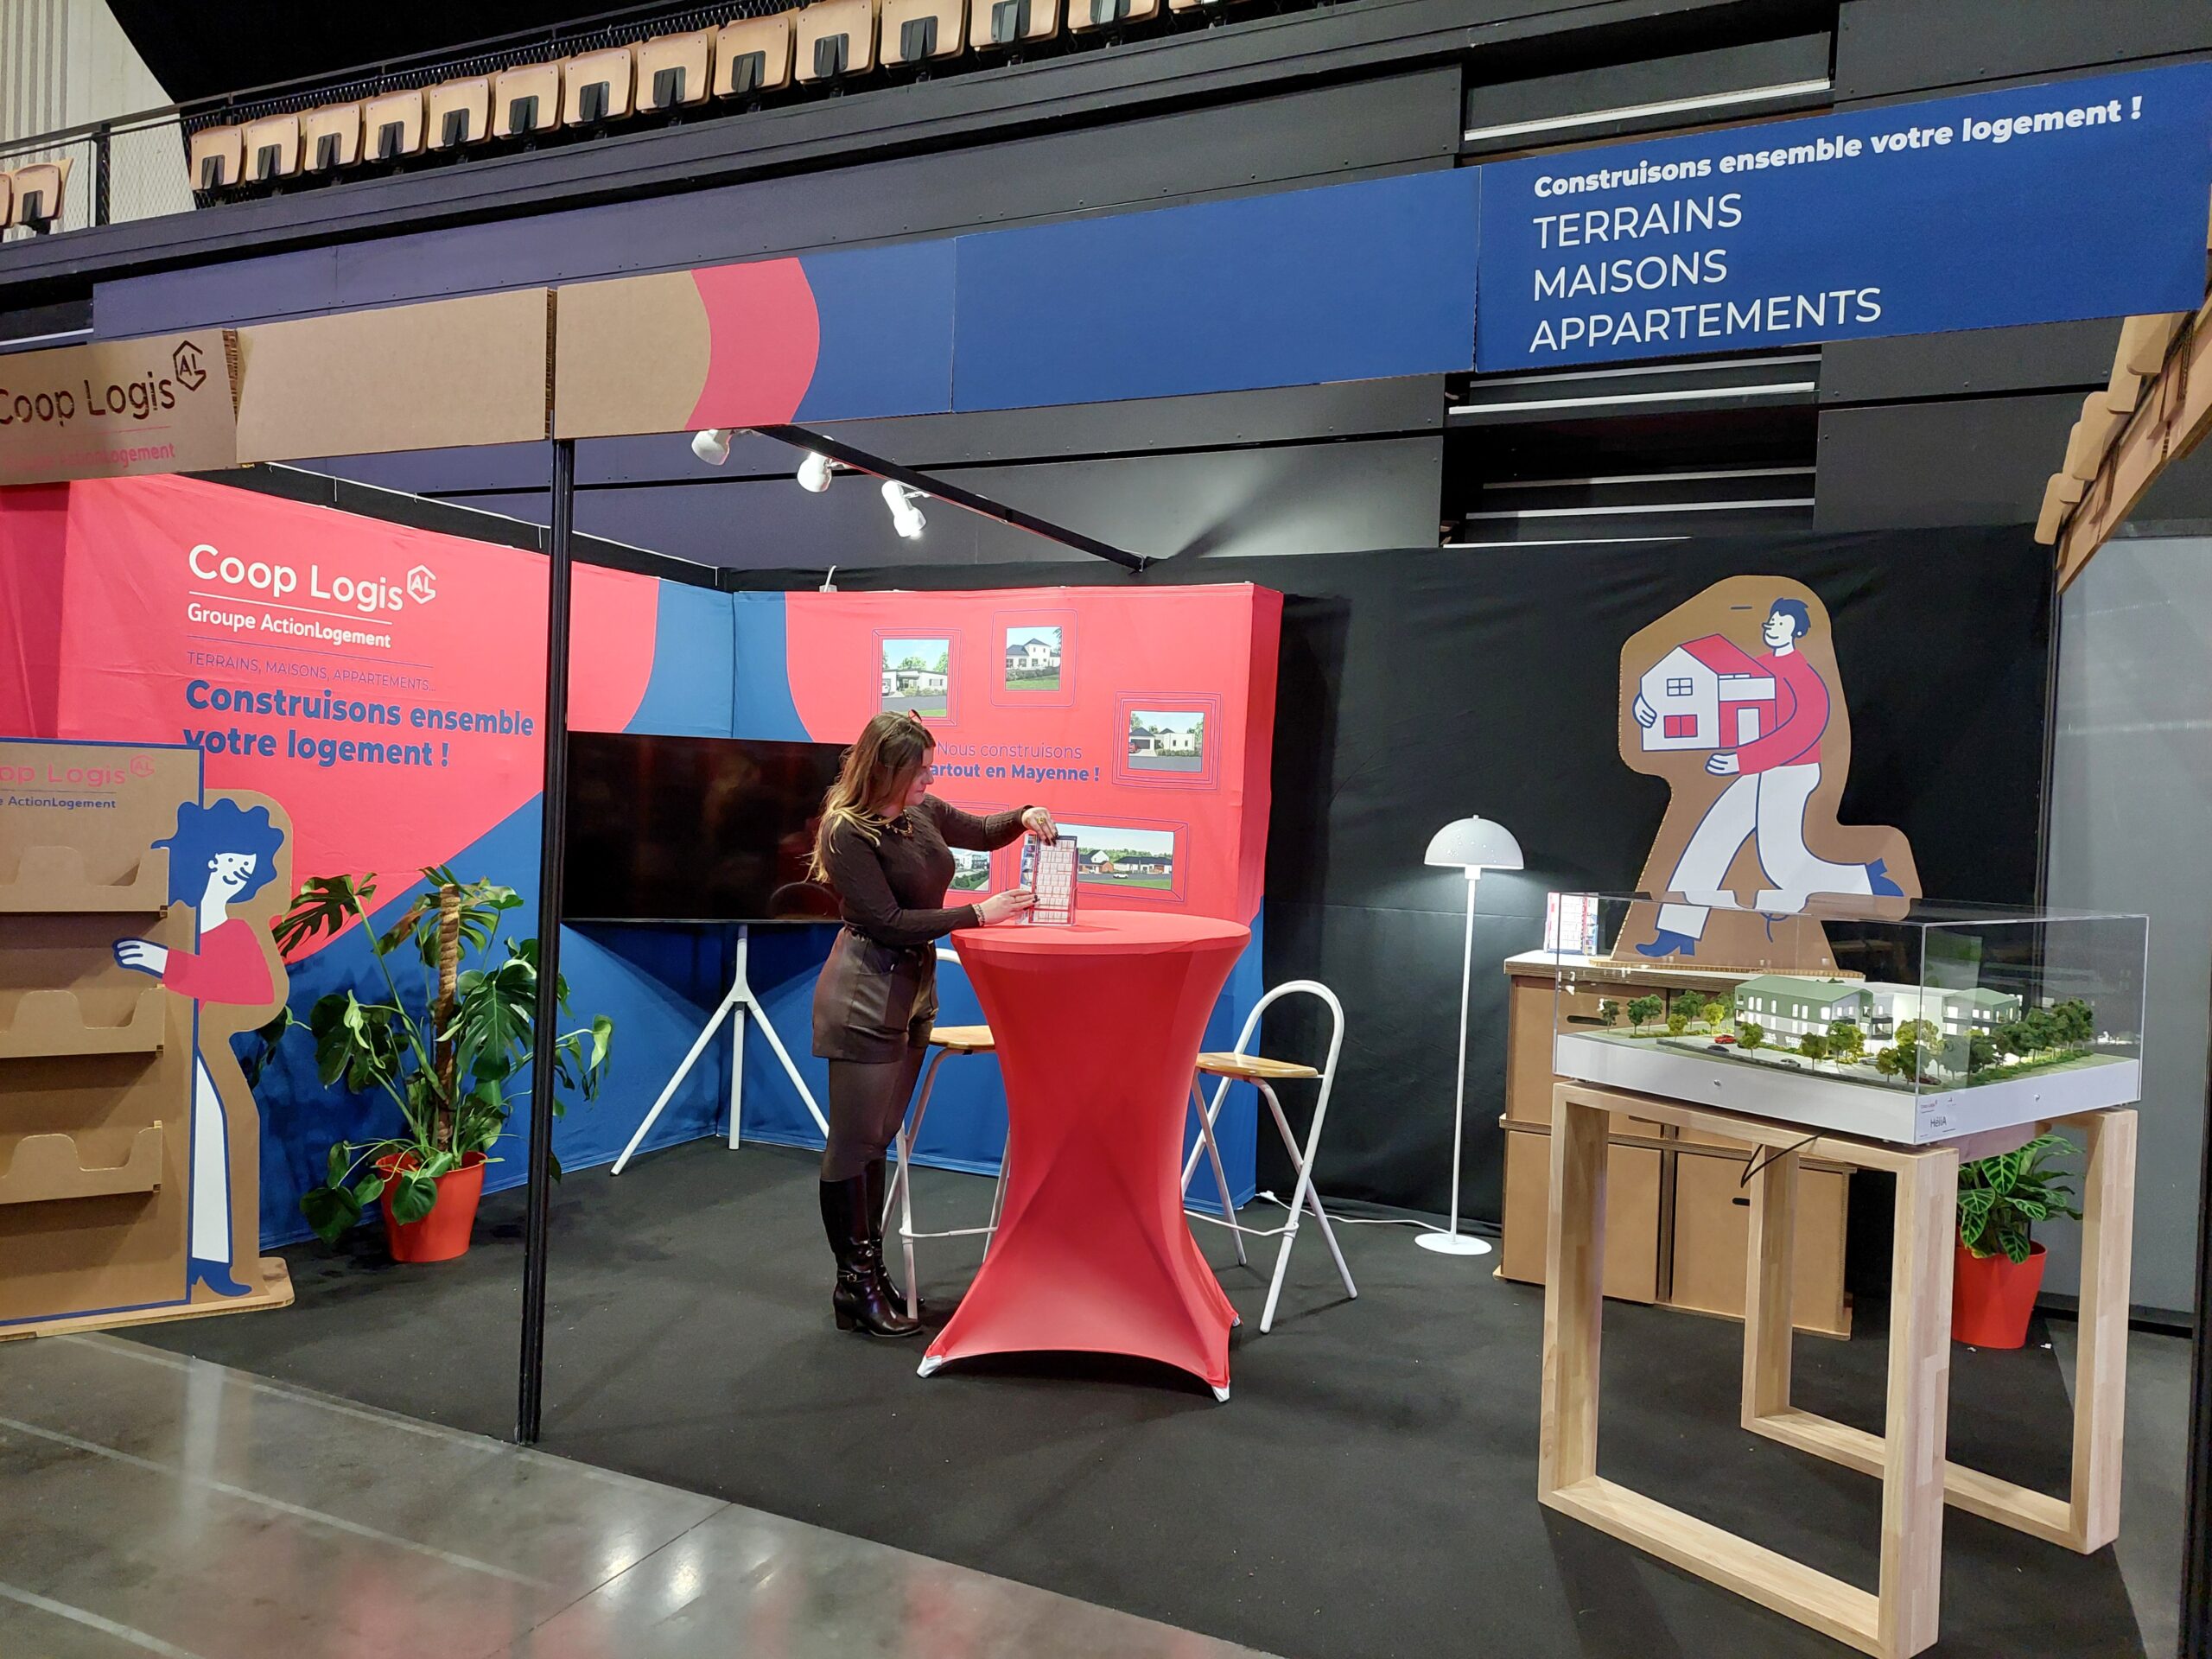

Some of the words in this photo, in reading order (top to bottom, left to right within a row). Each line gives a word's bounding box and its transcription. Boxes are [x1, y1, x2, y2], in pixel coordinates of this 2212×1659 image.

[1533, 156, 1712, 199] Construisons
[1719, 135, 1864, 175] ensemble
[1871, 123, 1953, 155] votre
[1961, 99, 2124, 145] logement
[2131, 95, 2143, 121] !
[1532, 192, 1743, 251] TERRAINS
[1533, 248, 1728, 302] MAISONS
[1529, 287, 1882, 354] APPARTEMENTS
[84, 371, 175, 420] Logis
[188, 543, 298, 598] Coop
[310, 563, 404, 613] Logis
[187, 602, 257, 632] Groupe
[260, 613, 391, 649] ActionLogement
[186, 651, 262, 674] TERRAINS,
[265, 659, 330, 682] MAISONS,
[185, 679, 402, 727] Construisons
[410, 705, 535, 737] ensemble
[183, 727, 277, 756] votre
[287, 728, 434, 767] logement
[441, 742, 450, 768] !
[938, 741, 976, 757] Nous
[980, 741, 1083, 760] construisons
[0, 765, 35, 785] op
[48, 762, 126, 788] Logis
[929, 763, 981, 778] artout
[985, 765, 1007, 779] en
[1012, 764, 1090, 784] Mayenne
[1094, 766, 1100, 782] !
[7, 795, 117, 810] ActionLogement
